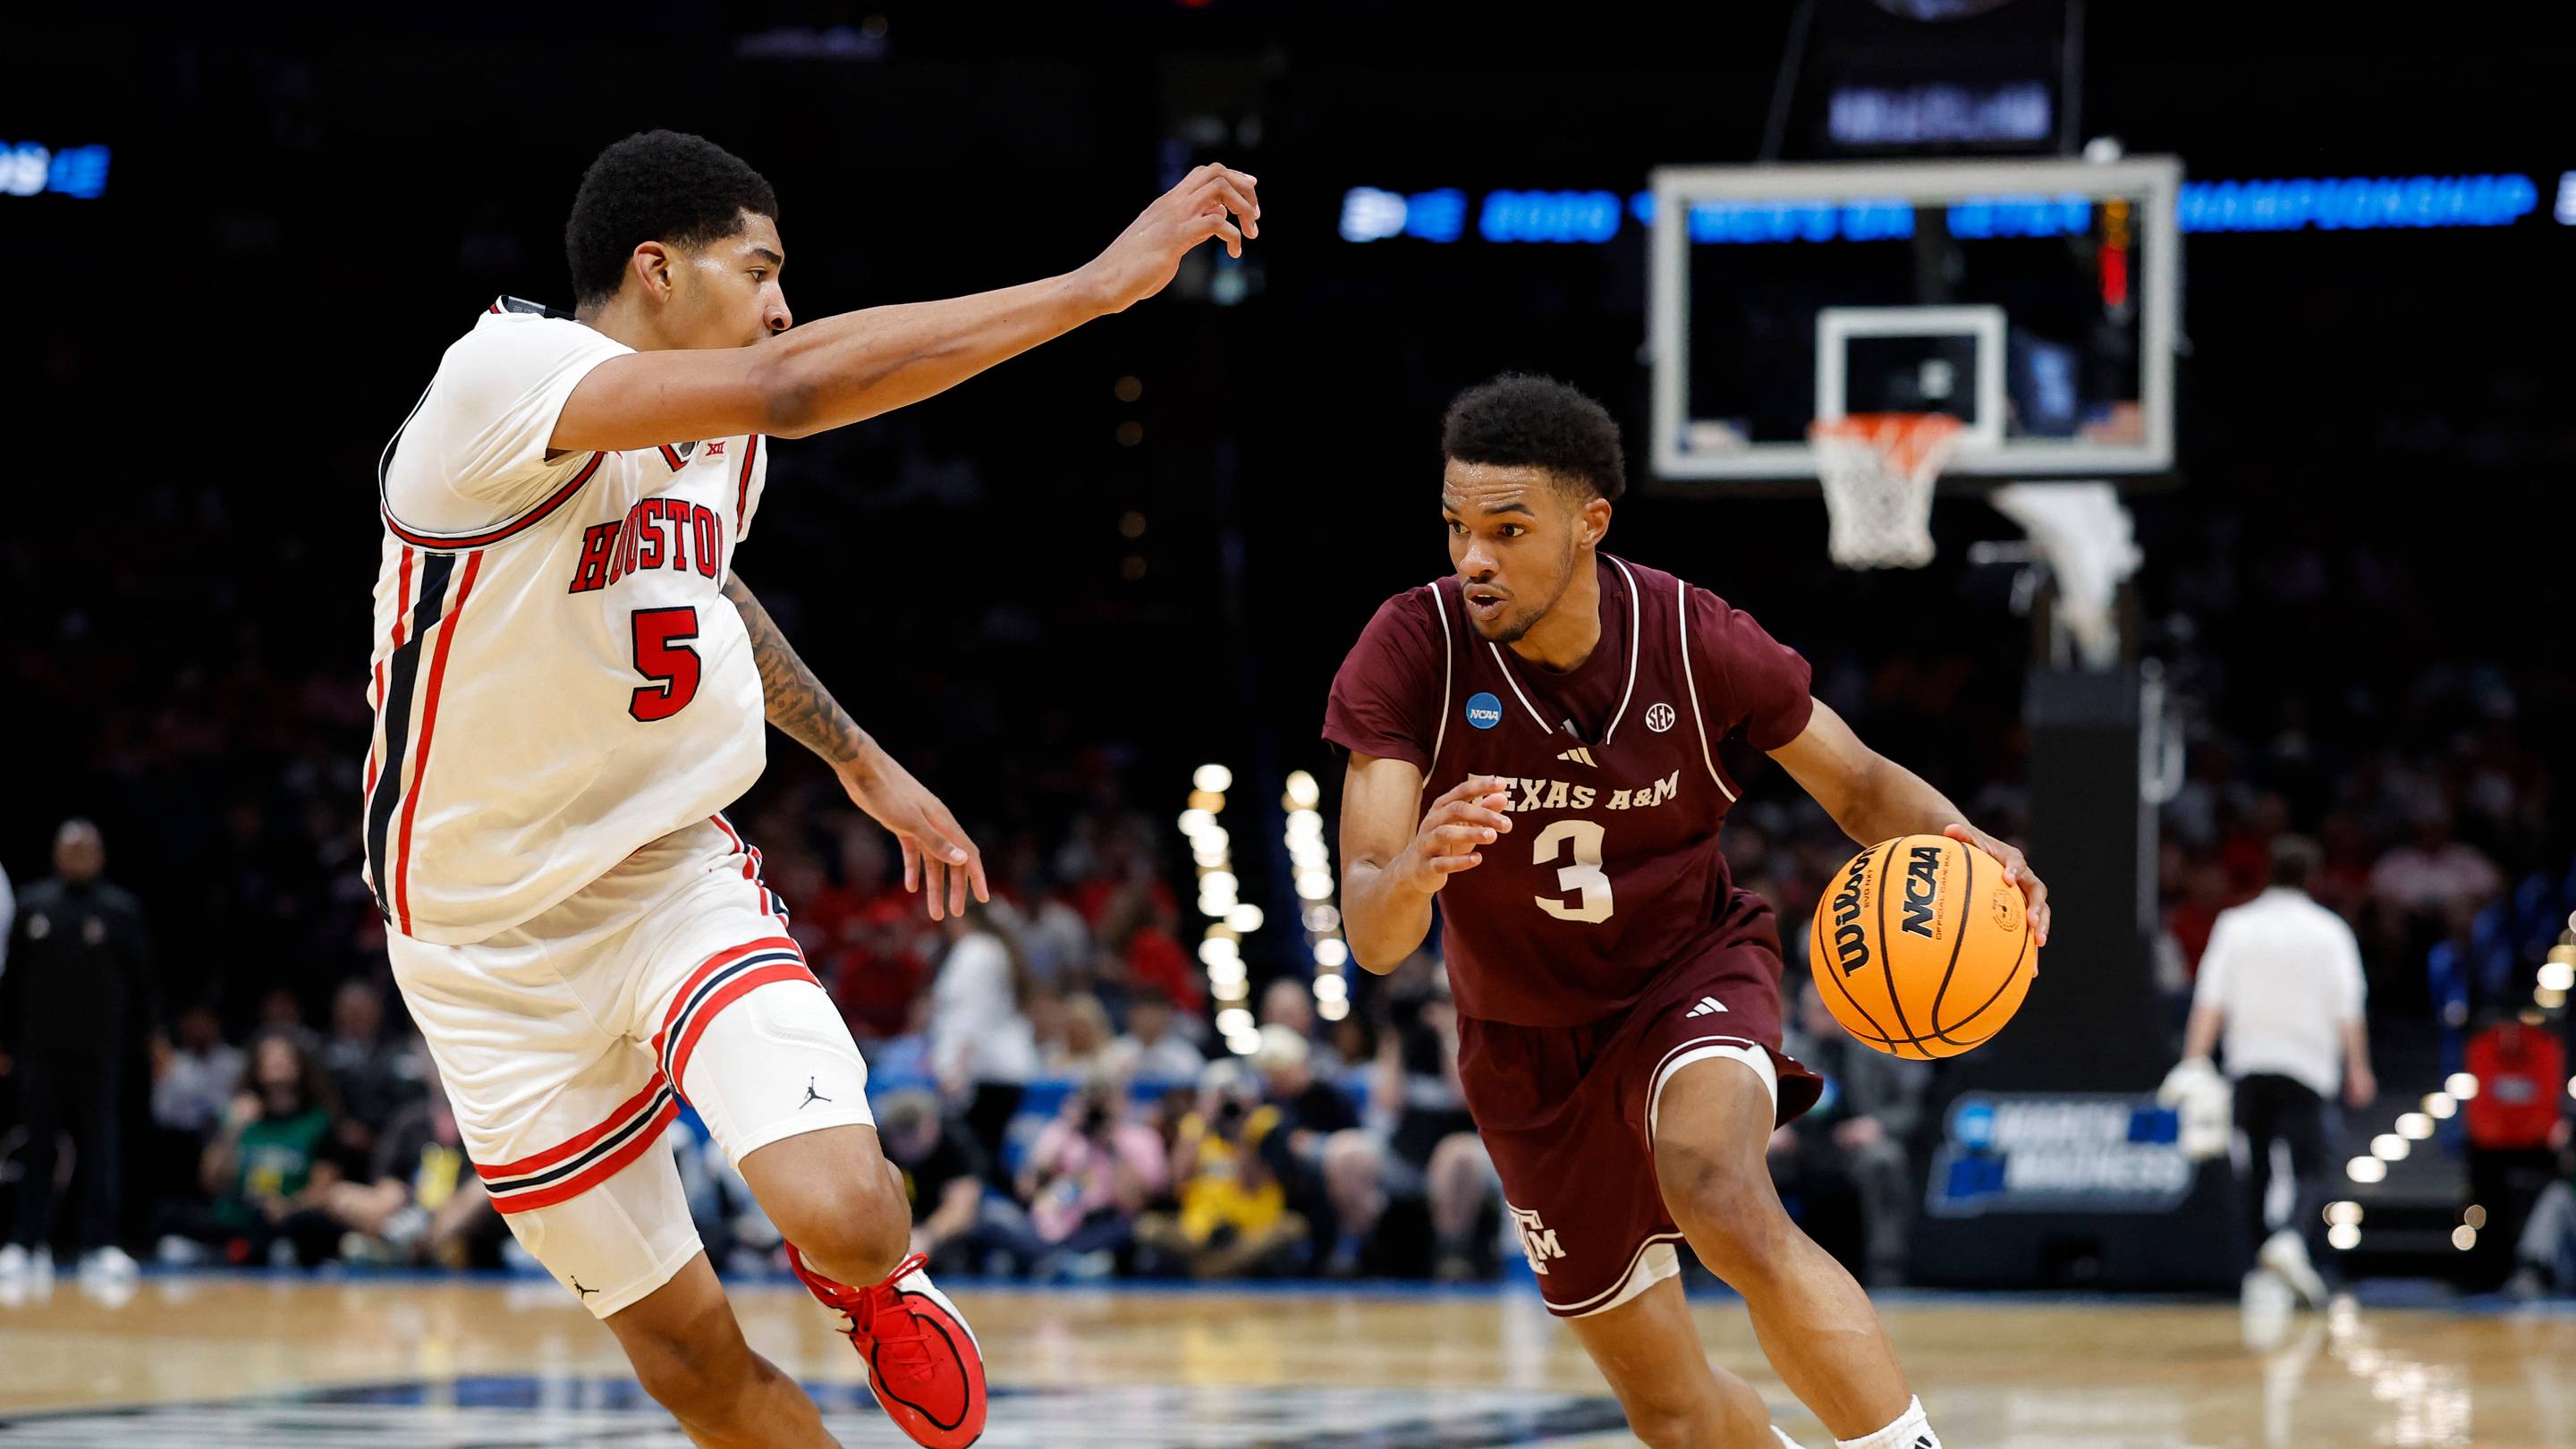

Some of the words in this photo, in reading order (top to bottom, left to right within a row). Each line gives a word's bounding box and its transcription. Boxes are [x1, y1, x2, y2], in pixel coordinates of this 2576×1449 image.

[2179, 174, 2538, 233] HAMPIONSHIP
[705, 441, 725, 456] XII
[629, 606, 701, 722] 5
[1470, 708, 1499, 720] NCAA
[1647, 704, 1674, 731] SEC
[1606, 769, 1680, 810] A&M
[1533, 819, 1614, 924] 3
[1902, 847, 1942, 938] NCAA
[1940, 869, 1948, 894] GAME
[1833, 842, 1885, 978] Wilson
[1936, 896, 1945, 940] OFFICIAL
